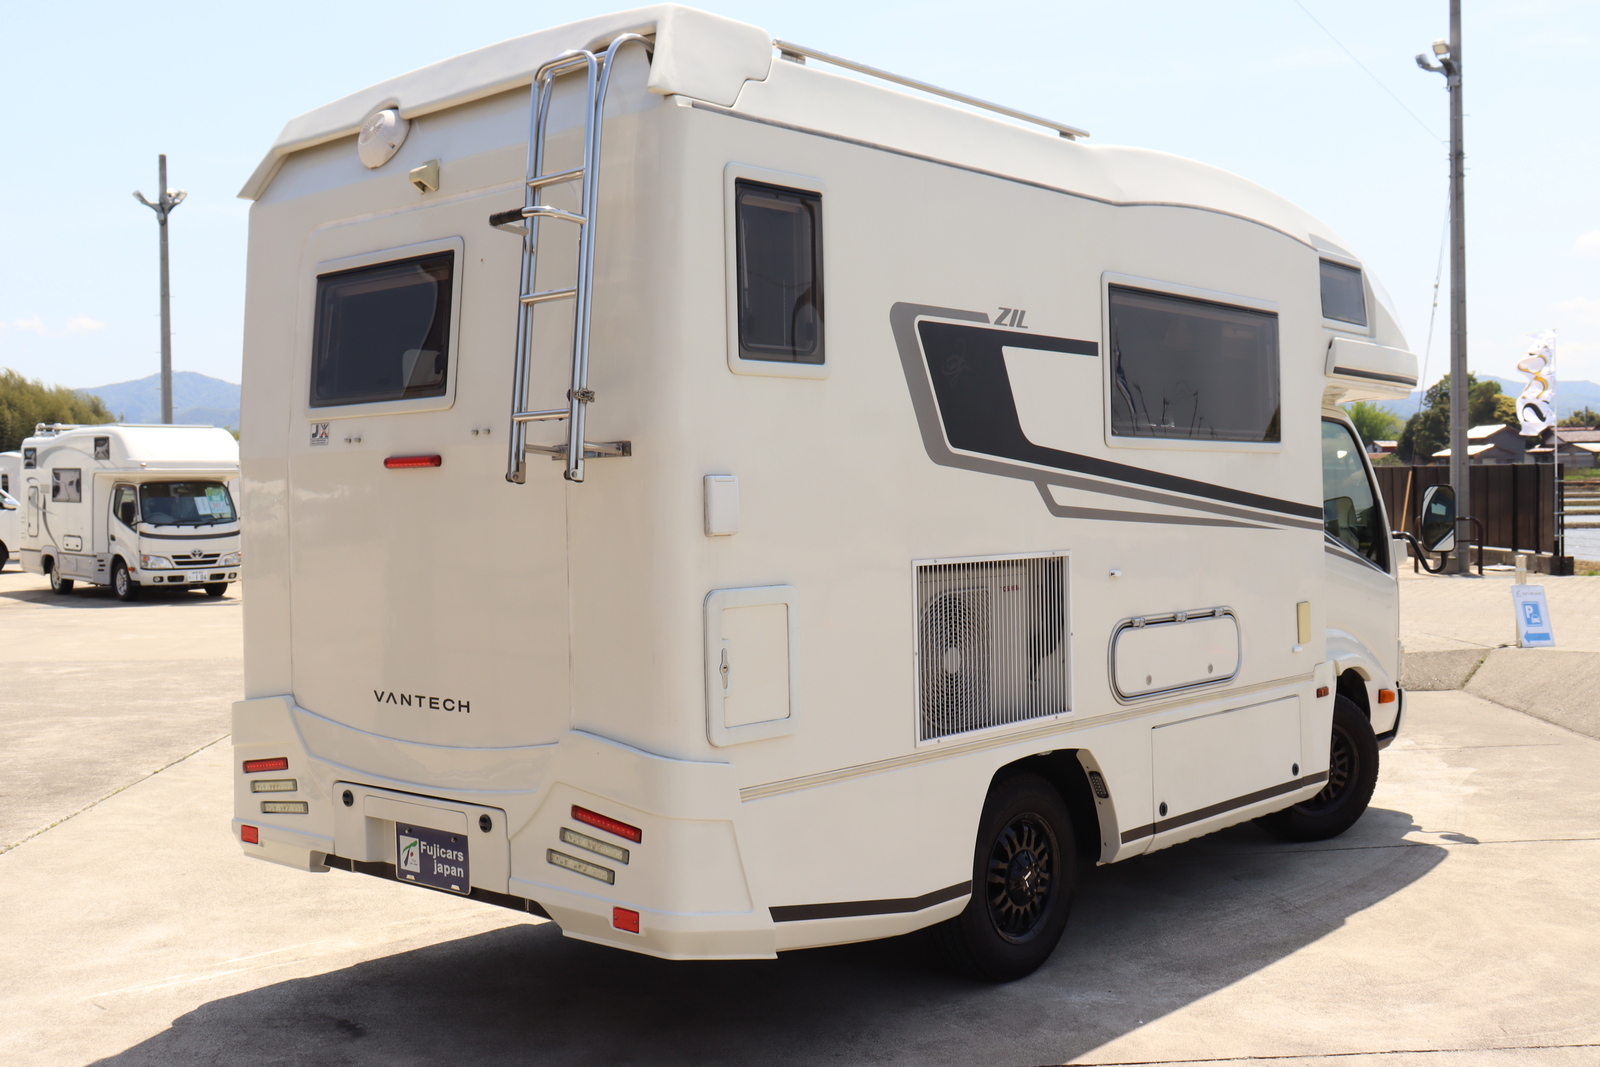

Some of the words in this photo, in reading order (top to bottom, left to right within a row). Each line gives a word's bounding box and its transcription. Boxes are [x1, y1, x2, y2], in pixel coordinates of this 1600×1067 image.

[994, 306, 1028, 328] ZIL
[373, 690, 470, 713] VANTECH
[420, 840, 464, 862] Fujicars
[433, 860, 464, 878] japan
